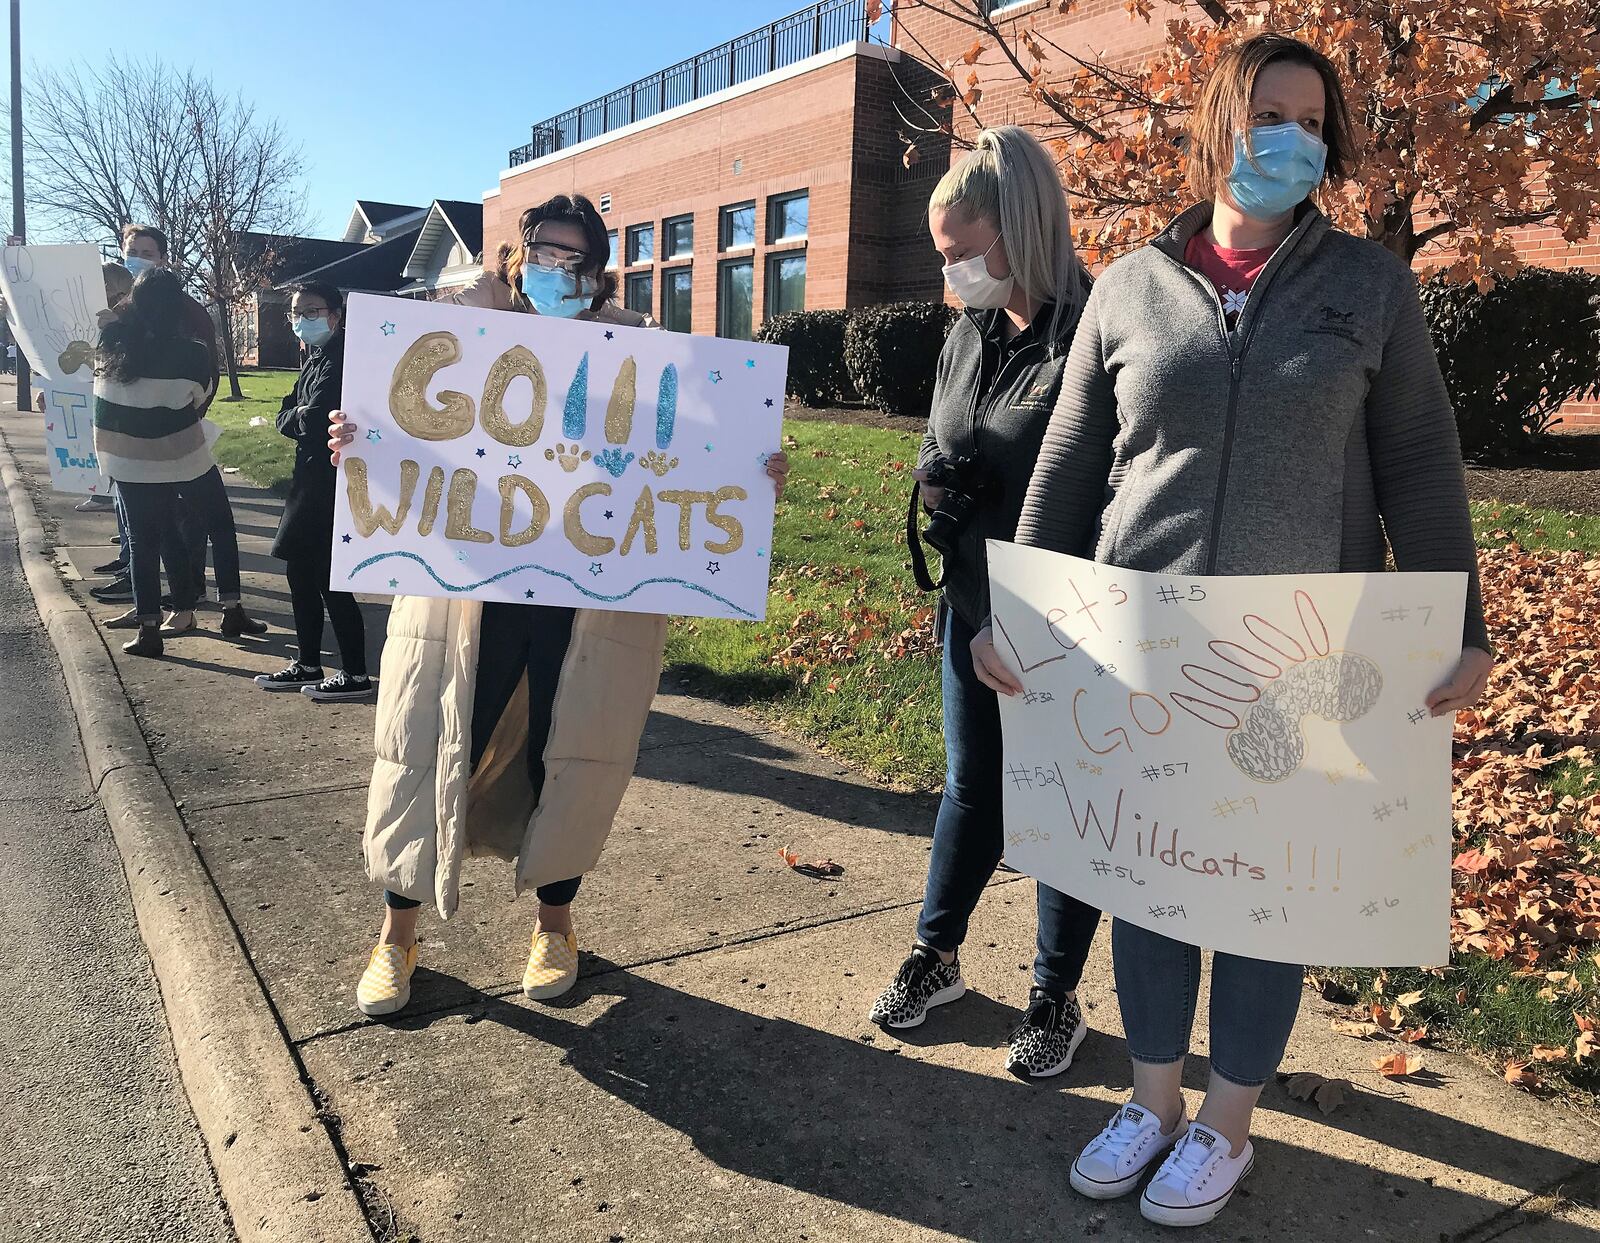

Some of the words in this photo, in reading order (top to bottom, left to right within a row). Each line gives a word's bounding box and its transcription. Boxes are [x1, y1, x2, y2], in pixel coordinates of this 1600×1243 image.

[343, 456, 748, 558] WILDCATS
[1155, 584, 1207, 604] #5
[994, 566, 1128, 673] Let's
[1380, 605, 1435, 626] #7
[1135, 636, 1179, 654] #54
[1093, 663, 1118, 677] #3
[1022, 688, 1055, 705] #32
[1006, 762, 1064, 791] #52
[1141, 762, 1189, 782] #57
[1211, 795, 1259, 818] #9
[1372, 795, 1409, 822] #4
[1090, 858, 1146, 886] #56
[1148, 904, 1187, 919] #24
[1249, 906, 1288, 925] #1
[1360, 897, 1400, 917] #6
